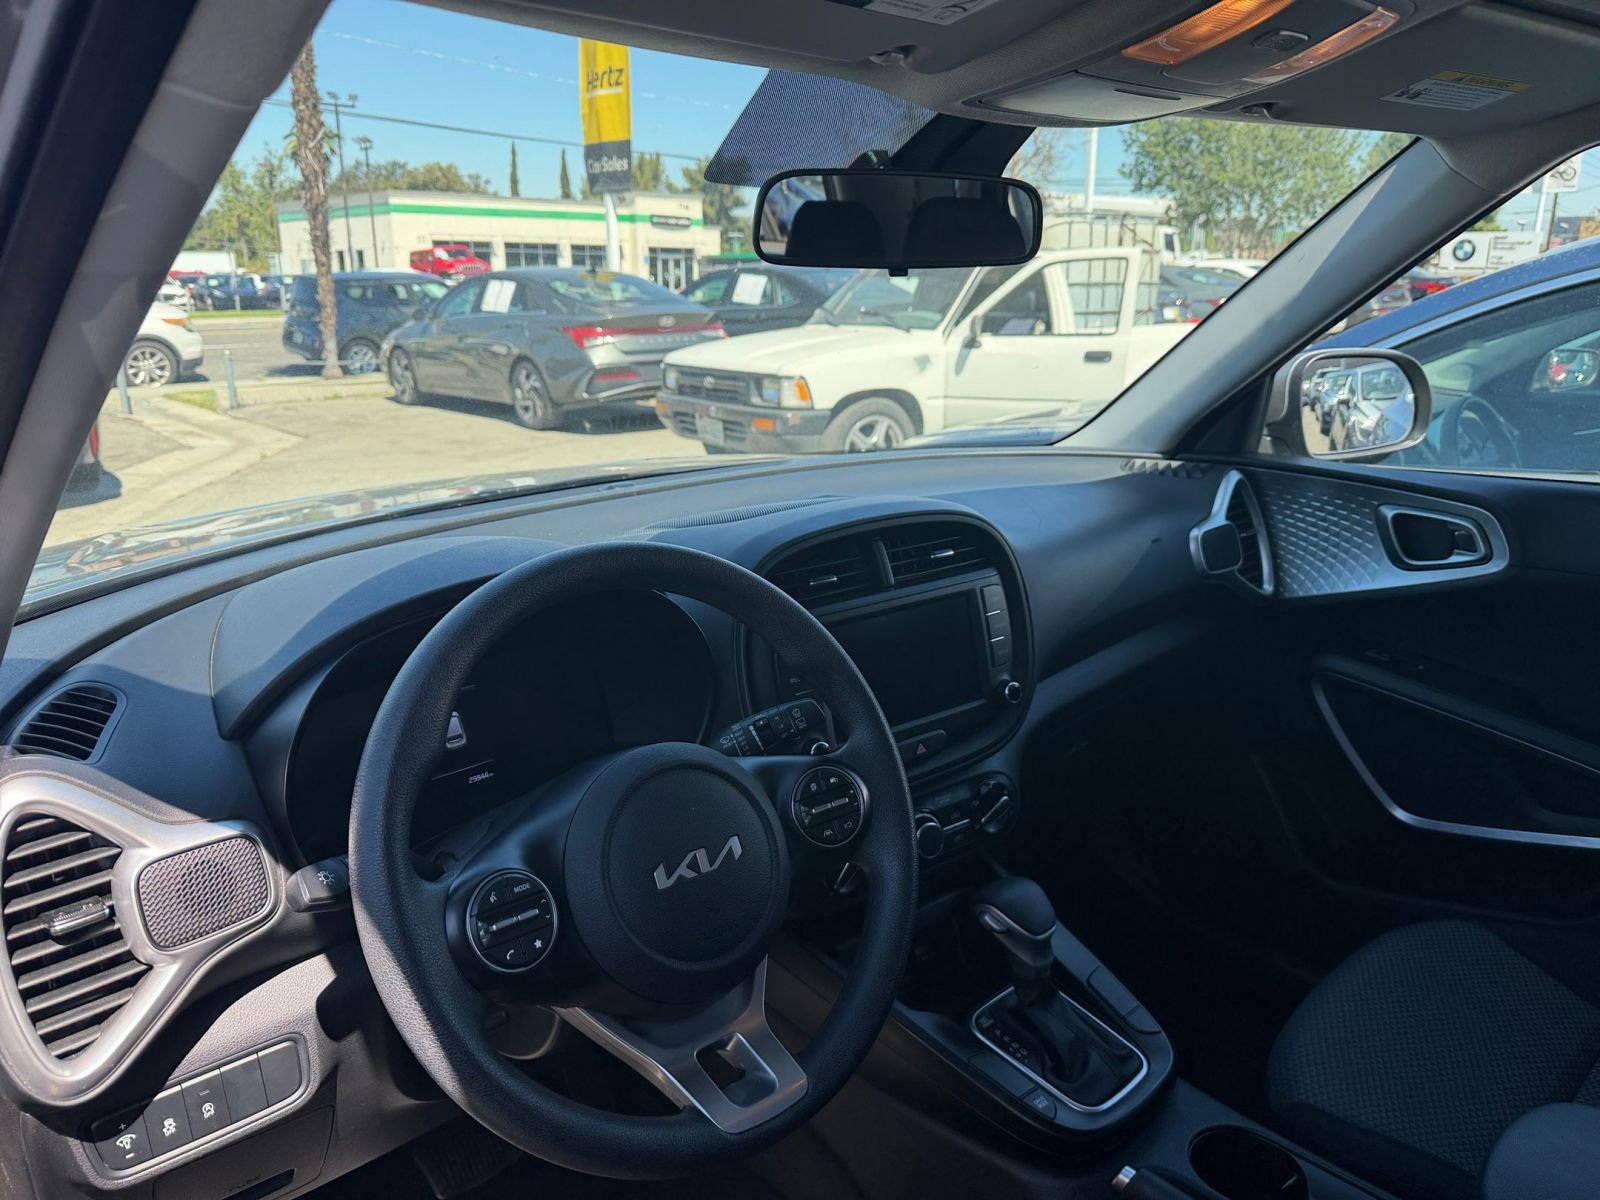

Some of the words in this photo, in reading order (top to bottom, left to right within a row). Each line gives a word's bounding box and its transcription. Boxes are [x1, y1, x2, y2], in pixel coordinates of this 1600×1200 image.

[587, 66, 624, 92] Hertz
[601, 156, 629, 172] Sales
[654, 835, 743, 890] KIA
[513, 882, 531, 893] MODE
